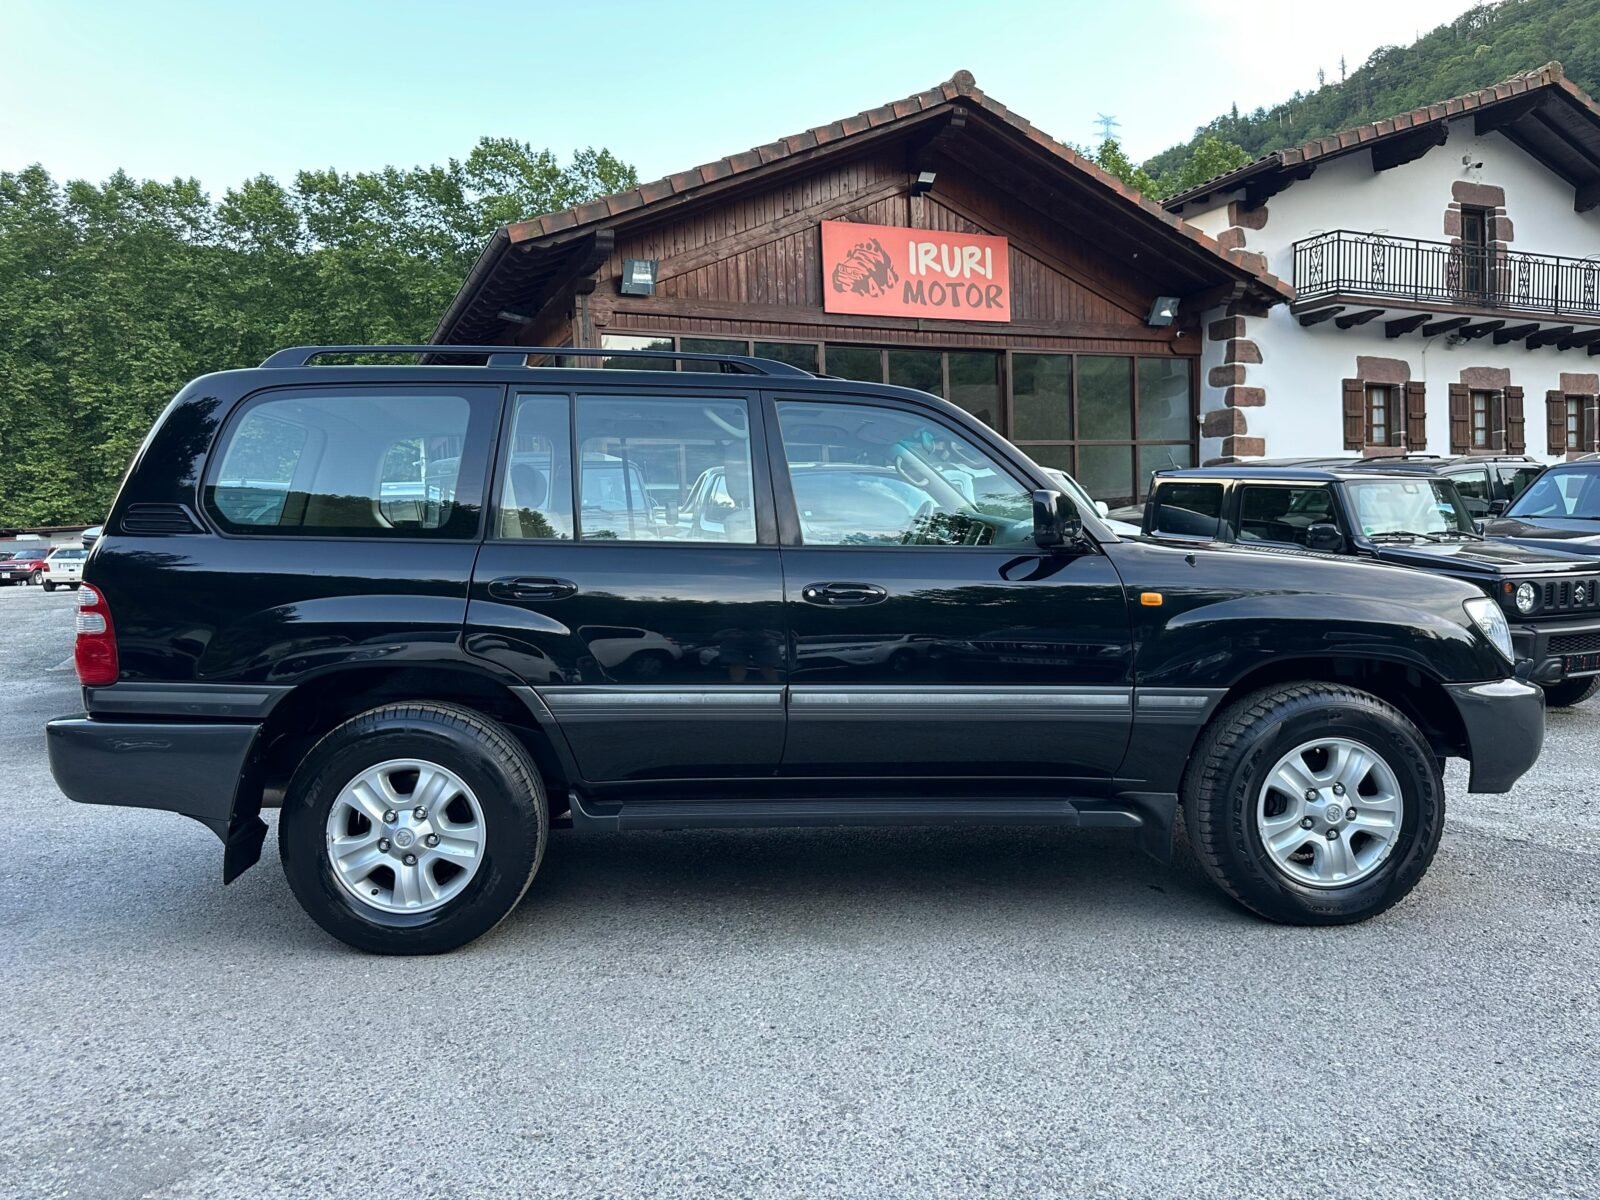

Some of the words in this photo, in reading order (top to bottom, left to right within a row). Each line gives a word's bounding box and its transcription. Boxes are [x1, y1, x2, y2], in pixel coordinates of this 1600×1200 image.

[908, 240, 993, 280] IRURI
[902, 279, 1004, 309] MOTOR
[1391, 731, 1436, 884] GOODYEA
